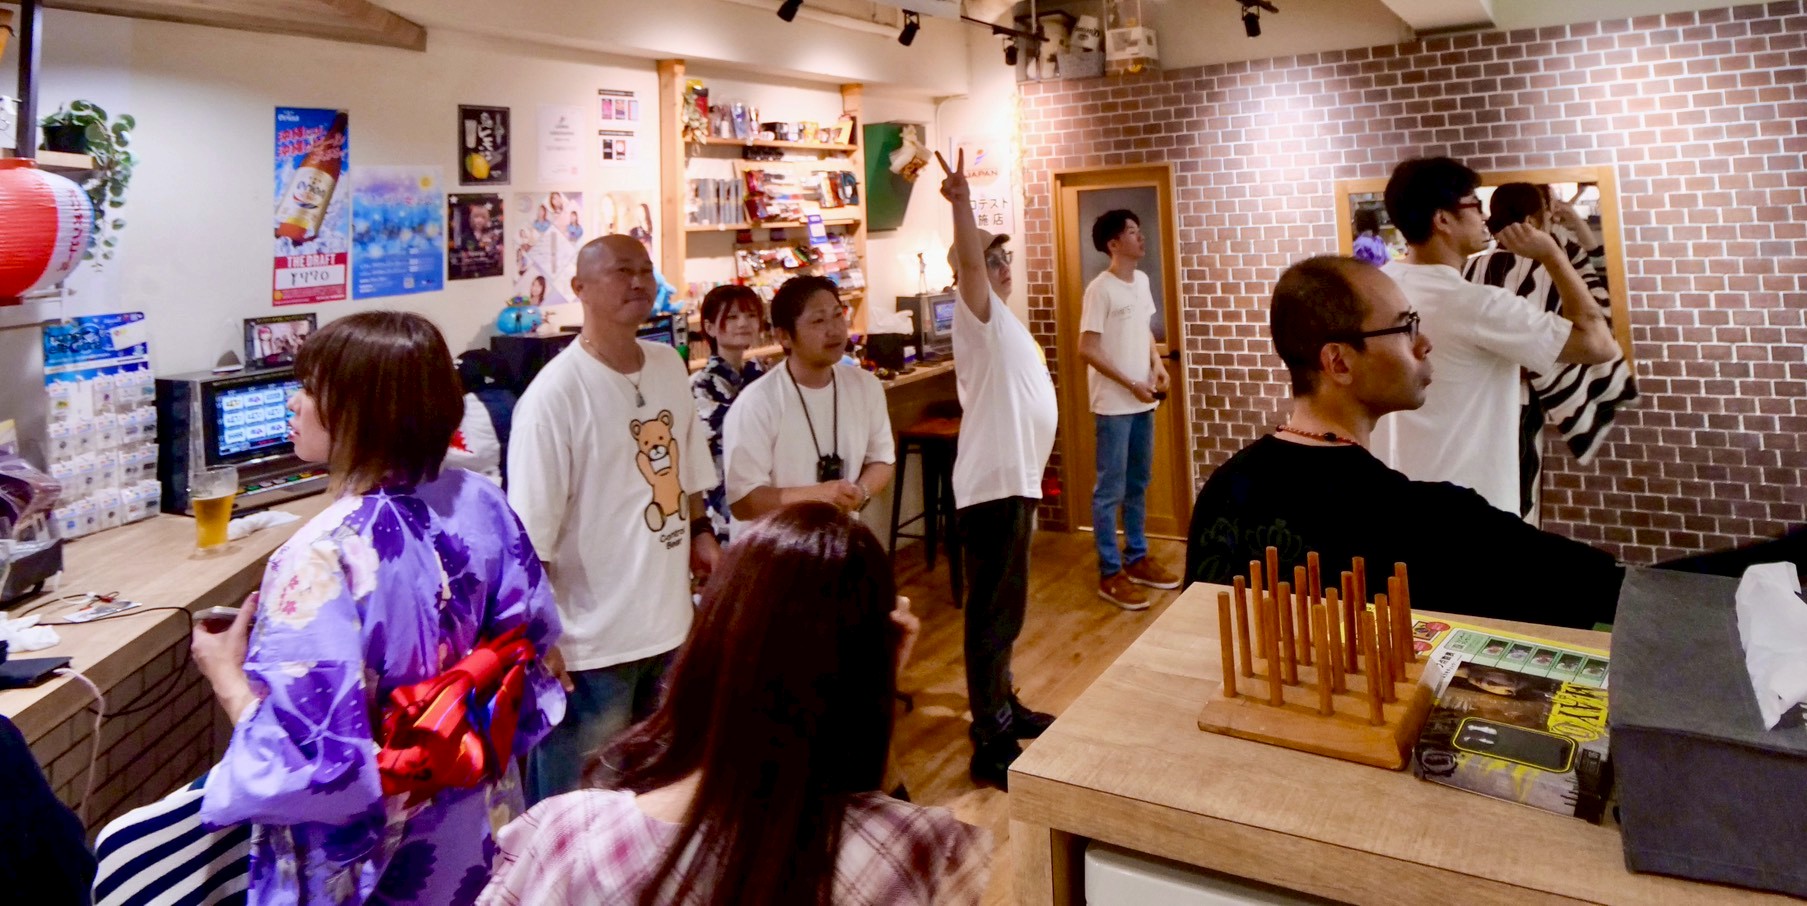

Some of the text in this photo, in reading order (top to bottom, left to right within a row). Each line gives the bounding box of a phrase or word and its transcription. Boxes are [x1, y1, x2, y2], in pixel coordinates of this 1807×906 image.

[964, 169, 998, 178] JAPAN
[287, 253, 336, 269] THE DRAFT
